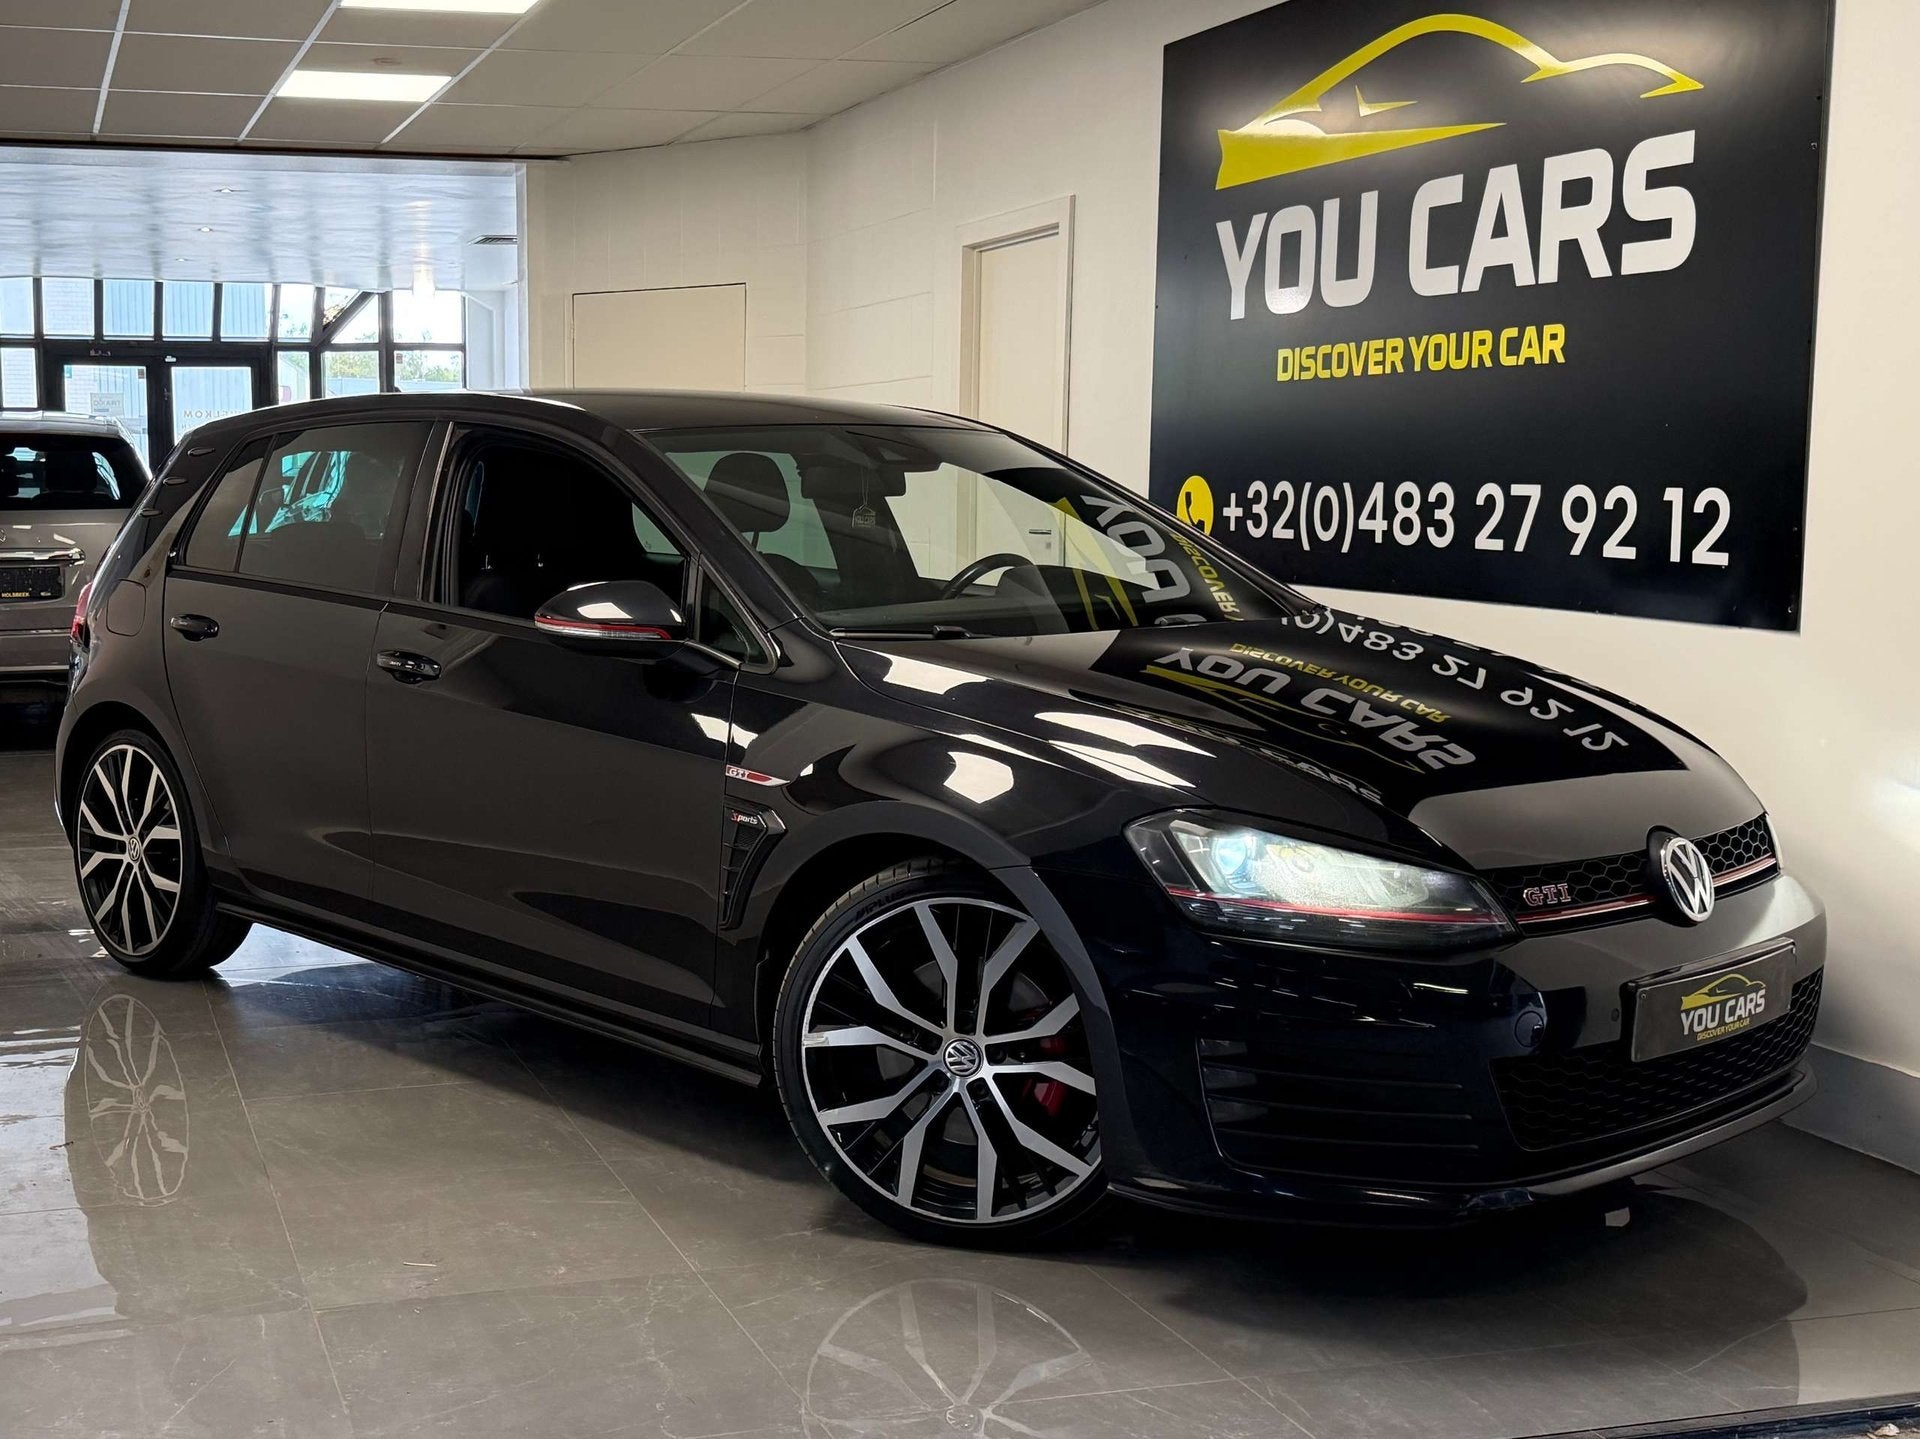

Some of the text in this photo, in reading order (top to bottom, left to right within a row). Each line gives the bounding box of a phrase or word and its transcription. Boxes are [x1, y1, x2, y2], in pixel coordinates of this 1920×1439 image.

[1215, 130, 1697, 321] YOU CARS
[1276, 323, 1567, 382] DISCOVER YOUR CAR
[1222, 480, 1732, 567] +32(0)483 27 92 12
[728, 768, 748, 779] GTI
[1523, 883, 1571, 907] GTI
[1681, 989, 1765, 1035] YOU CARS
[1696, 1018, 1750, 1041] DISCOVER YOUR CAR
